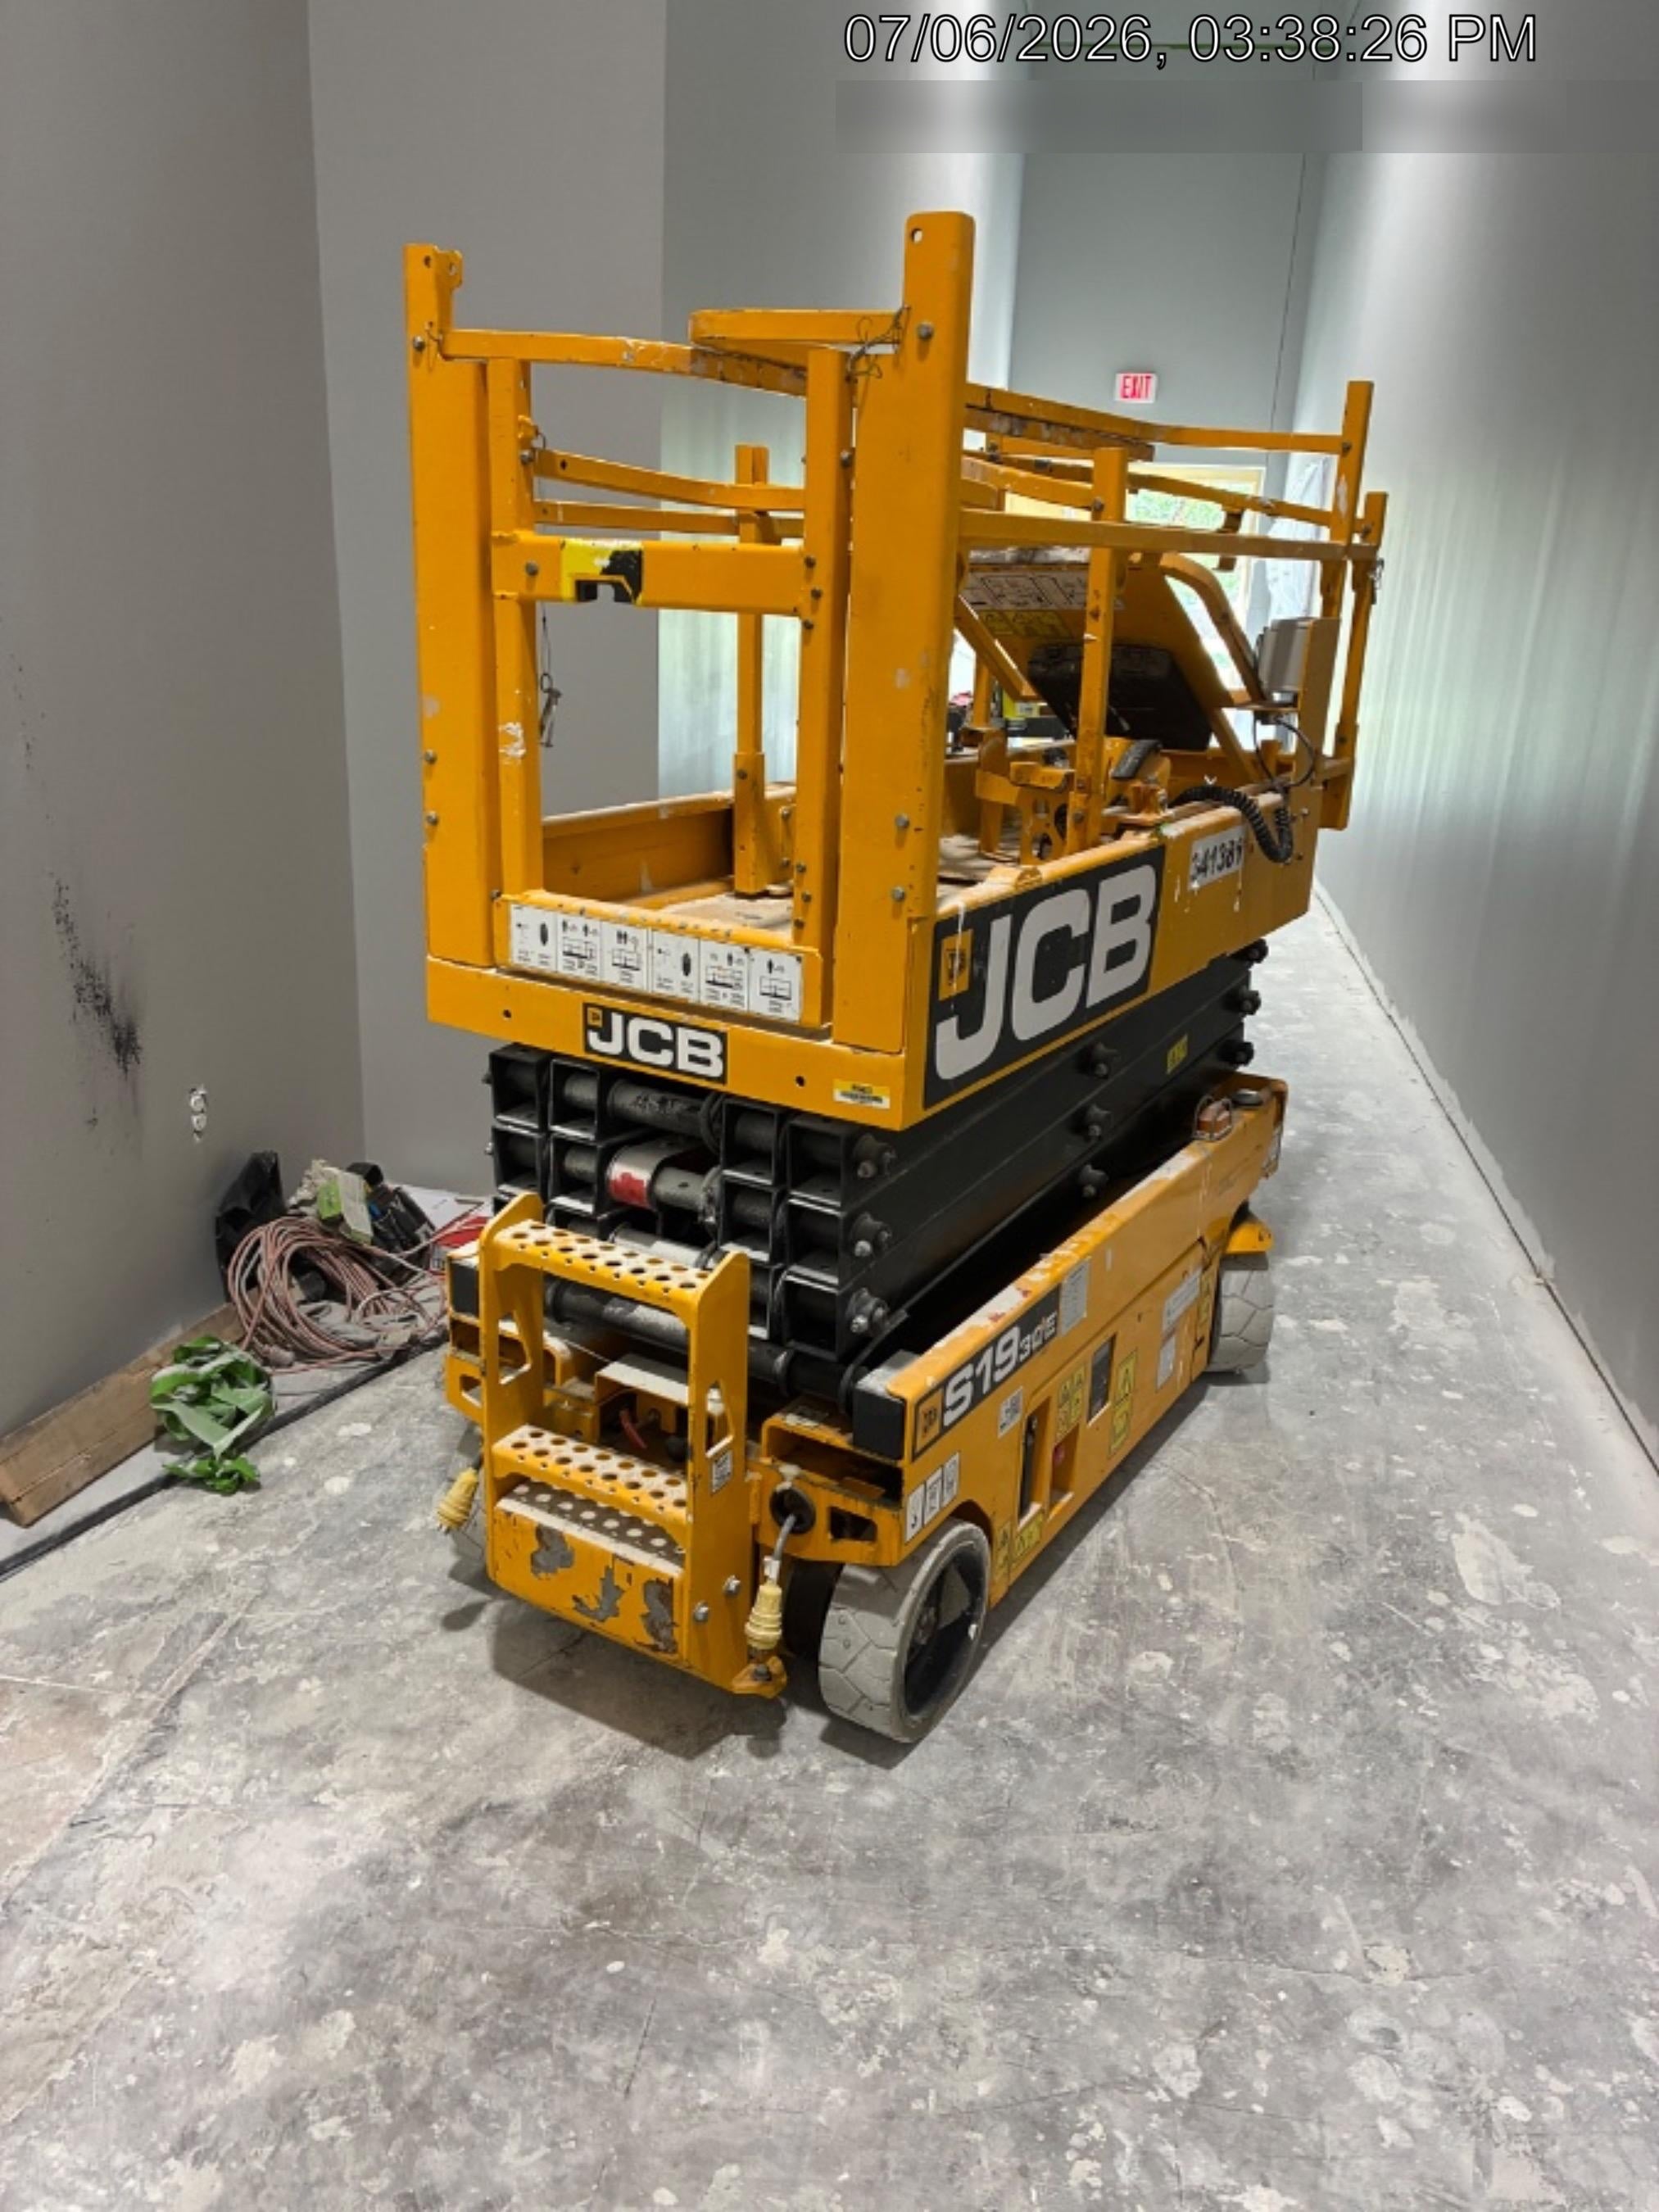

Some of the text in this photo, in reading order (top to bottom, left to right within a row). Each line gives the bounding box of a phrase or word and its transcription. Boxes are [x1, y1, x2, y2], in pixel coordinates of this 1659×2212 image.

[1121, 374, 1152, 399] EXIT
[936, 863, 1157, 1081] JCB
[587, 1011, 724, 1078] JCB
